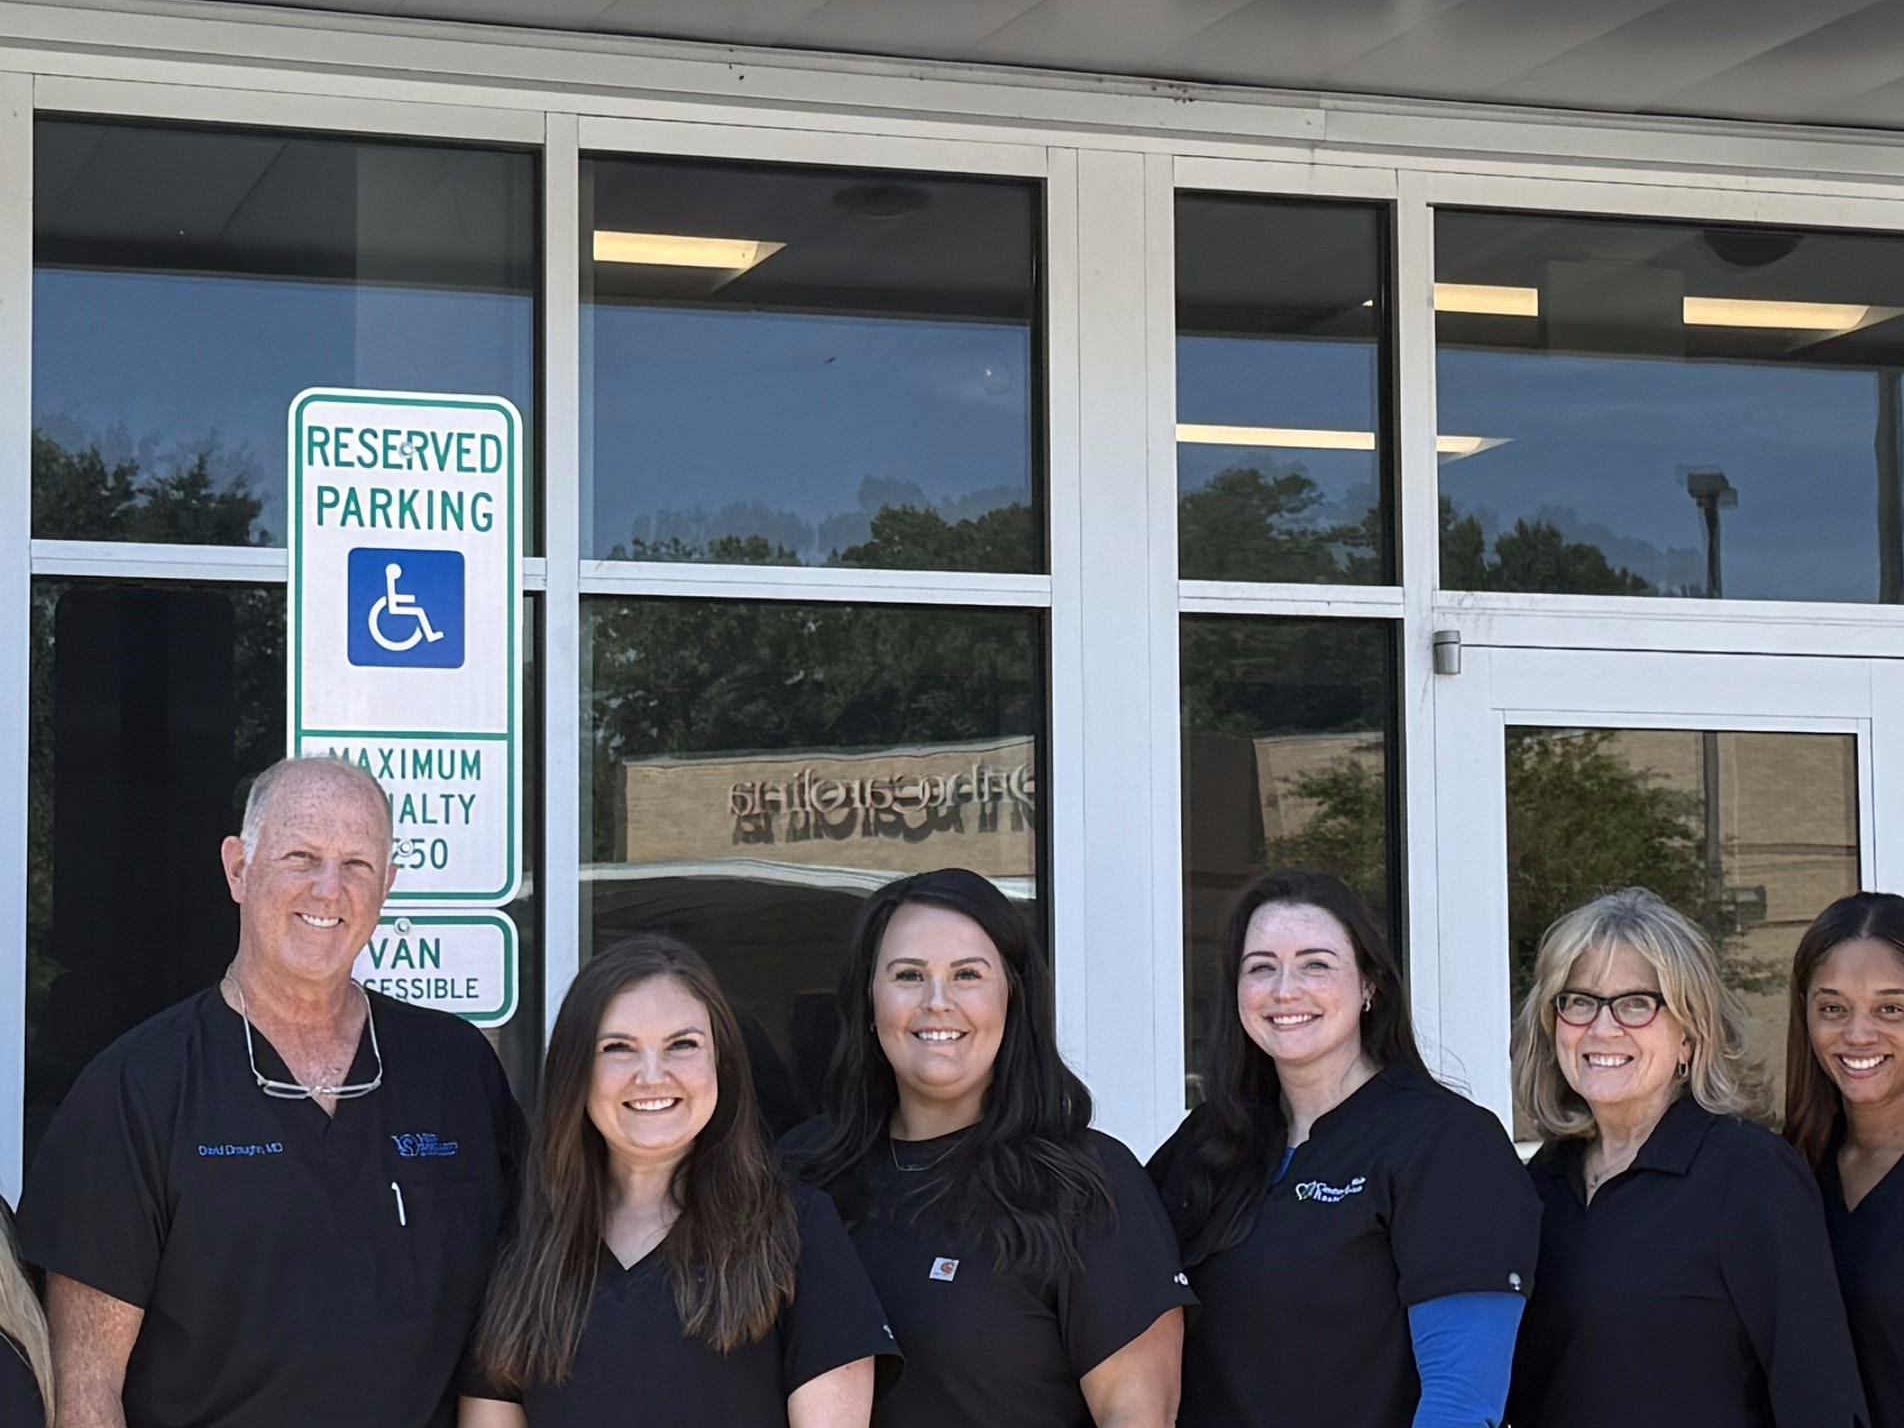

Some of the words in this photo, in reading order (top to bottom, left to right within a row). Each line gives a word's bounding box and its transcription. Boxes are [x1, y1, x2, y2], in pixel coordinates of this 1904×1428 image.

[307, 425, 502, 473] RESERVED
[317, 485, 493, 533] PARKING
[389, 793, 476, 825] ALTY
[367, 937, 441, 970] VAN
[363, 977, 480, 1000] CESSIBLE
